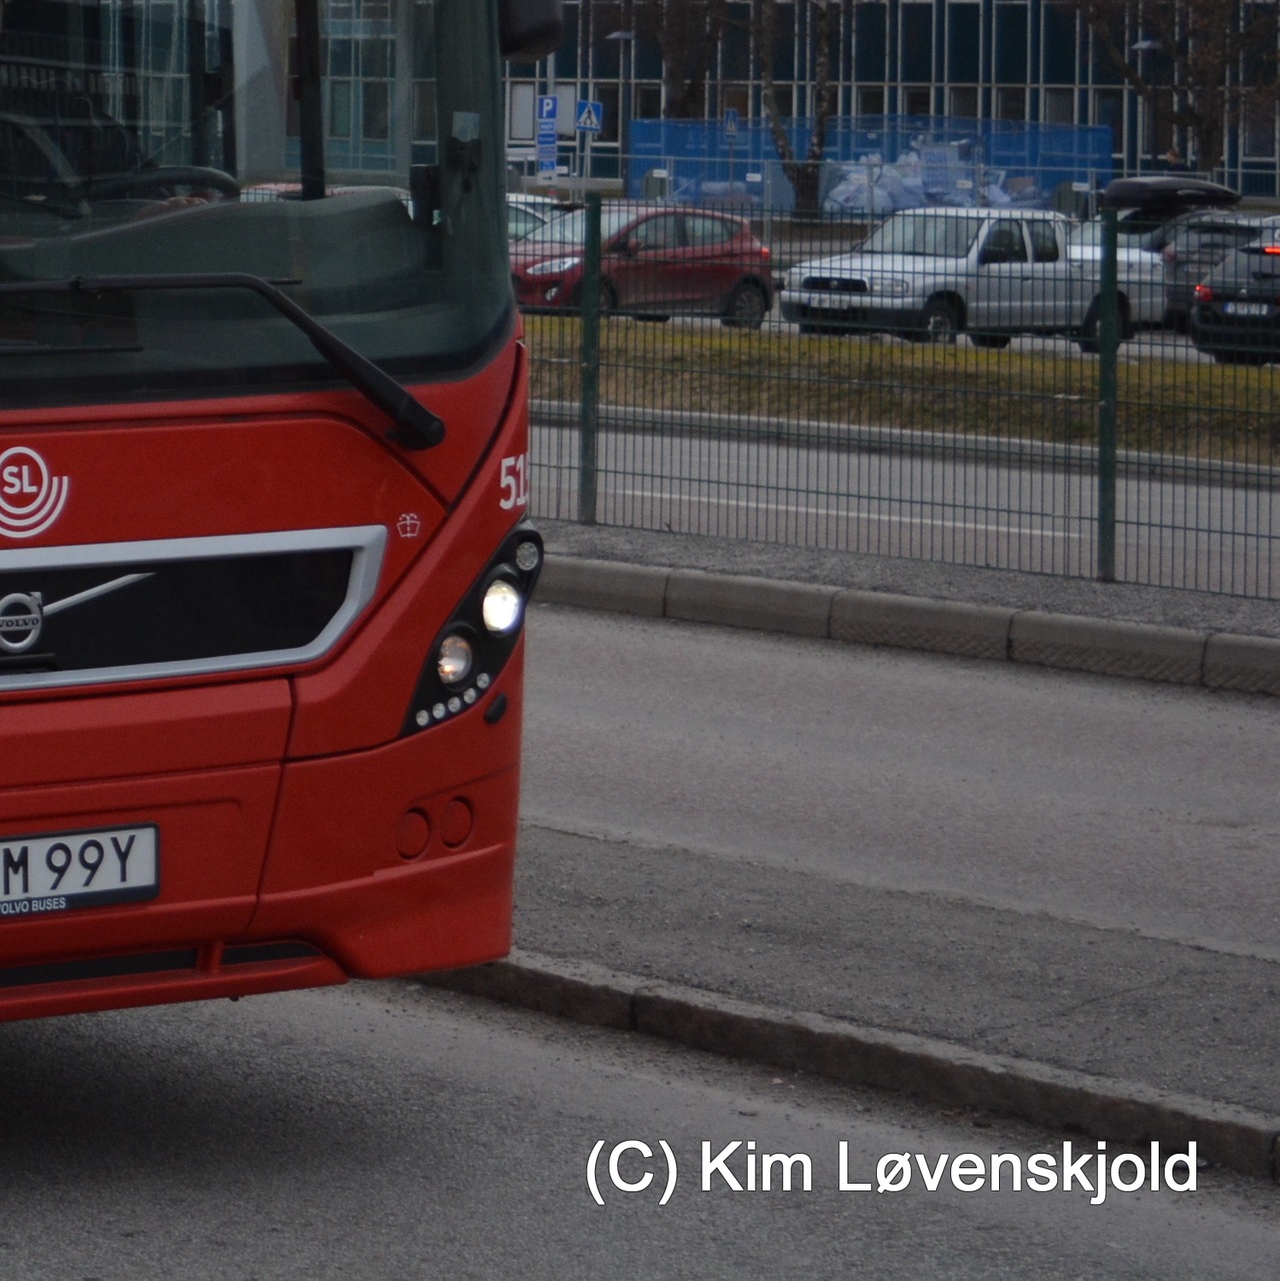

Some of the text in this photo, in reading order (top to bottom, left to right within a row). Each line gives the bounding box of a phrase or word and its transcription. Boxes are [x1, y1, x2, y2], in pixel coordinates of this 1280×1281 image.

[543, 99, 553, 118] P
[2, 464, 38, 495] SL
[499, 454, 529, 510] 51
[44, 833, 136, 891] 99Y
[31, 896, 67, 913] BUSES
